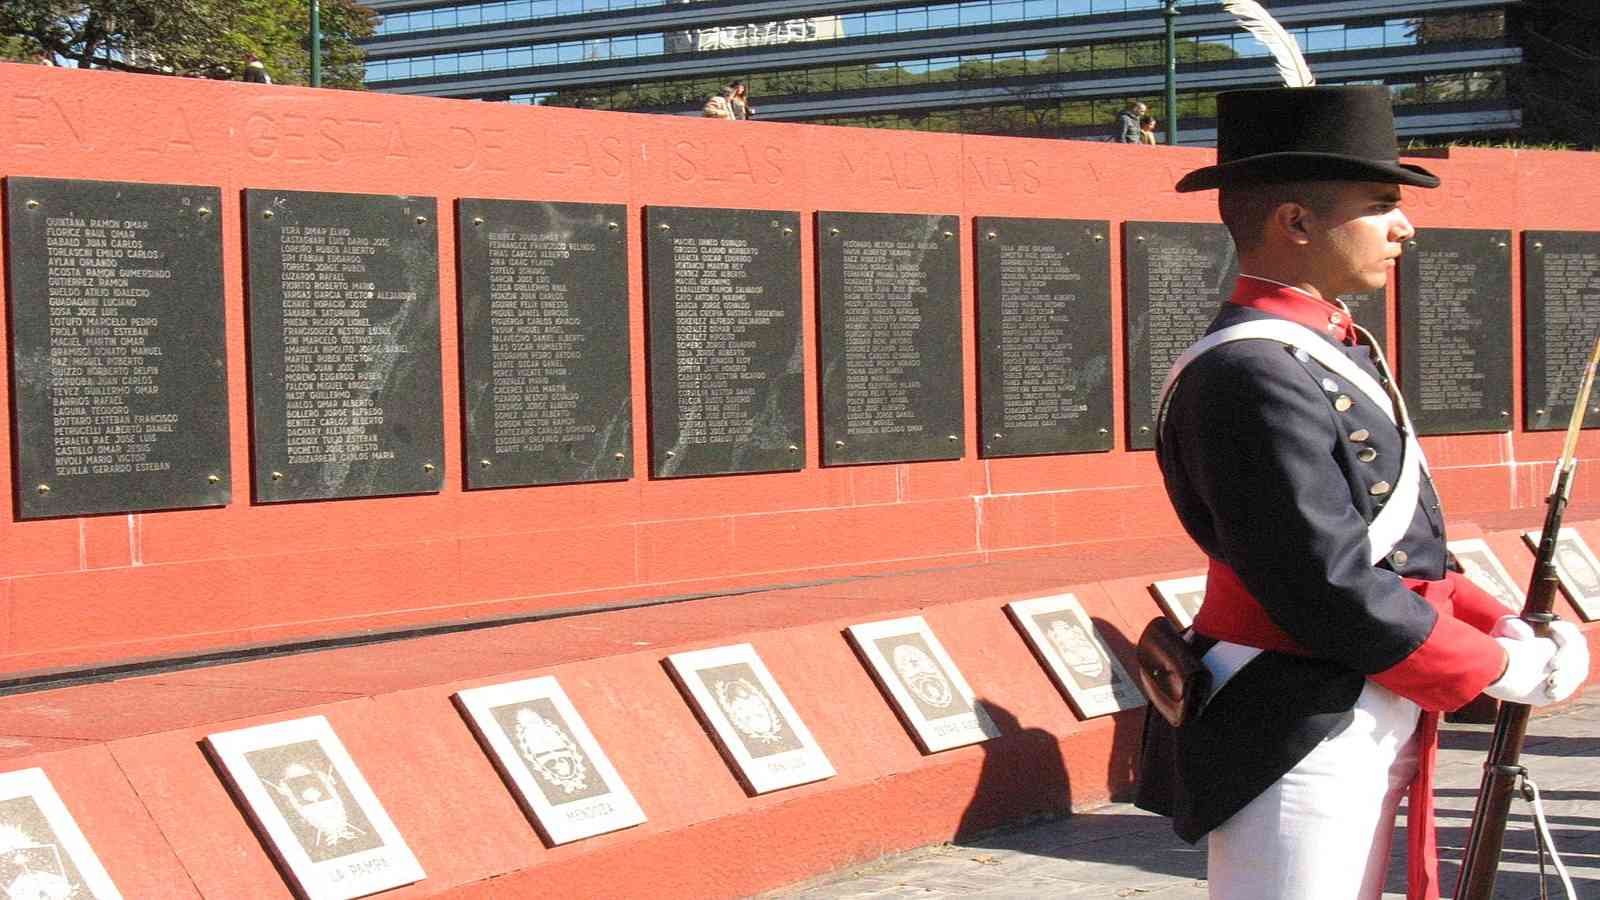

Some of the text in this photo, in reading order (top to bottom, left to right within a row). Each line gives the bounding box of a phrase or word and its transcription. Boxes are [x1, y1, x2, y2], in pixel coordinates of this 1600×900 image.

[244, 109, 413, 162] GESTA
[448, 124, 507, 171] DE
[544, 132, 624, 178] LAS
[664, 136, 785, 185] ISLAS
[46, 218, 147, 230] QUINTANA RAMON OMAR
[84, 229, 104, 238] RAUL
[111, 230, 135, 239] OMAR
[86, 239, 142, 249] JUAN CARLOS
[96, 249, 157, 259] EMILIO CARLOS
[79, 258, 117, 267] ORLANDO
[48, 267, 80, 276] ACOSTA
[85, 268, 115, 277] RAMON
[48, 277, 128, 287] GUTIERREZ RAMON
[49, 287, 80, 296] SUELDO
[102, 298, 136, 306] LUCIANO
[50, 307, 117, 316] SOSA JOSE LUIS
[86, 317, 126, 326] MARCELO
[130, 318, 157, 326] PEDRO
[82, 327, 109, 335] MARIO
[113, 328, 148, 336] ESTEBAN
[51, 337, 144, 345] MACIEL MARTIN OMAR
[302, 336, 337, 344] MARCELO
[131, 347, 162, 355] MANUEL
[52, 357, 143, 365] PAZ MIGUEL ROBERTO
[98, 376, 117, 384] JUAN
[121, 376, 152, 384] CARLOS
[286, 373, 316, 381] MORENO
[84, 386, 130, 394] GUILLERMO
[134, 386, 159, 394] OMAR
[286, 382, 313, 390] FALCON
[53, 396, 123, 405] BARRIOS RAFAEL
[342, 398, 373, 407] ALBERTO
[54, 406, 128, 414] LAGUNA TEODORO
[94, 415, 130, 424] ESTEBAN
[134, 415, 178, 423] FRANCISCO
[319, 417, 347, 426] CARLOS
[352, 416, 383, 424] ALBERTO
[106, 425, 142, 433] ALBERTO
[145, 424, 173, 433] DANIEL
[55, 434, 156, 444] PERALTA JOSE LUIS
[55, 446, 93, 454] CASTILLO
[97, 445, 121, 453] OMAR
[85, 455, 112, 464] MARIO
[117, 454, 144, 463] VICTOR
[56, 463, 170, 474] SEVILLA GERARDO ESTEBAN
[347, 856, 393, 879] PAMPA
